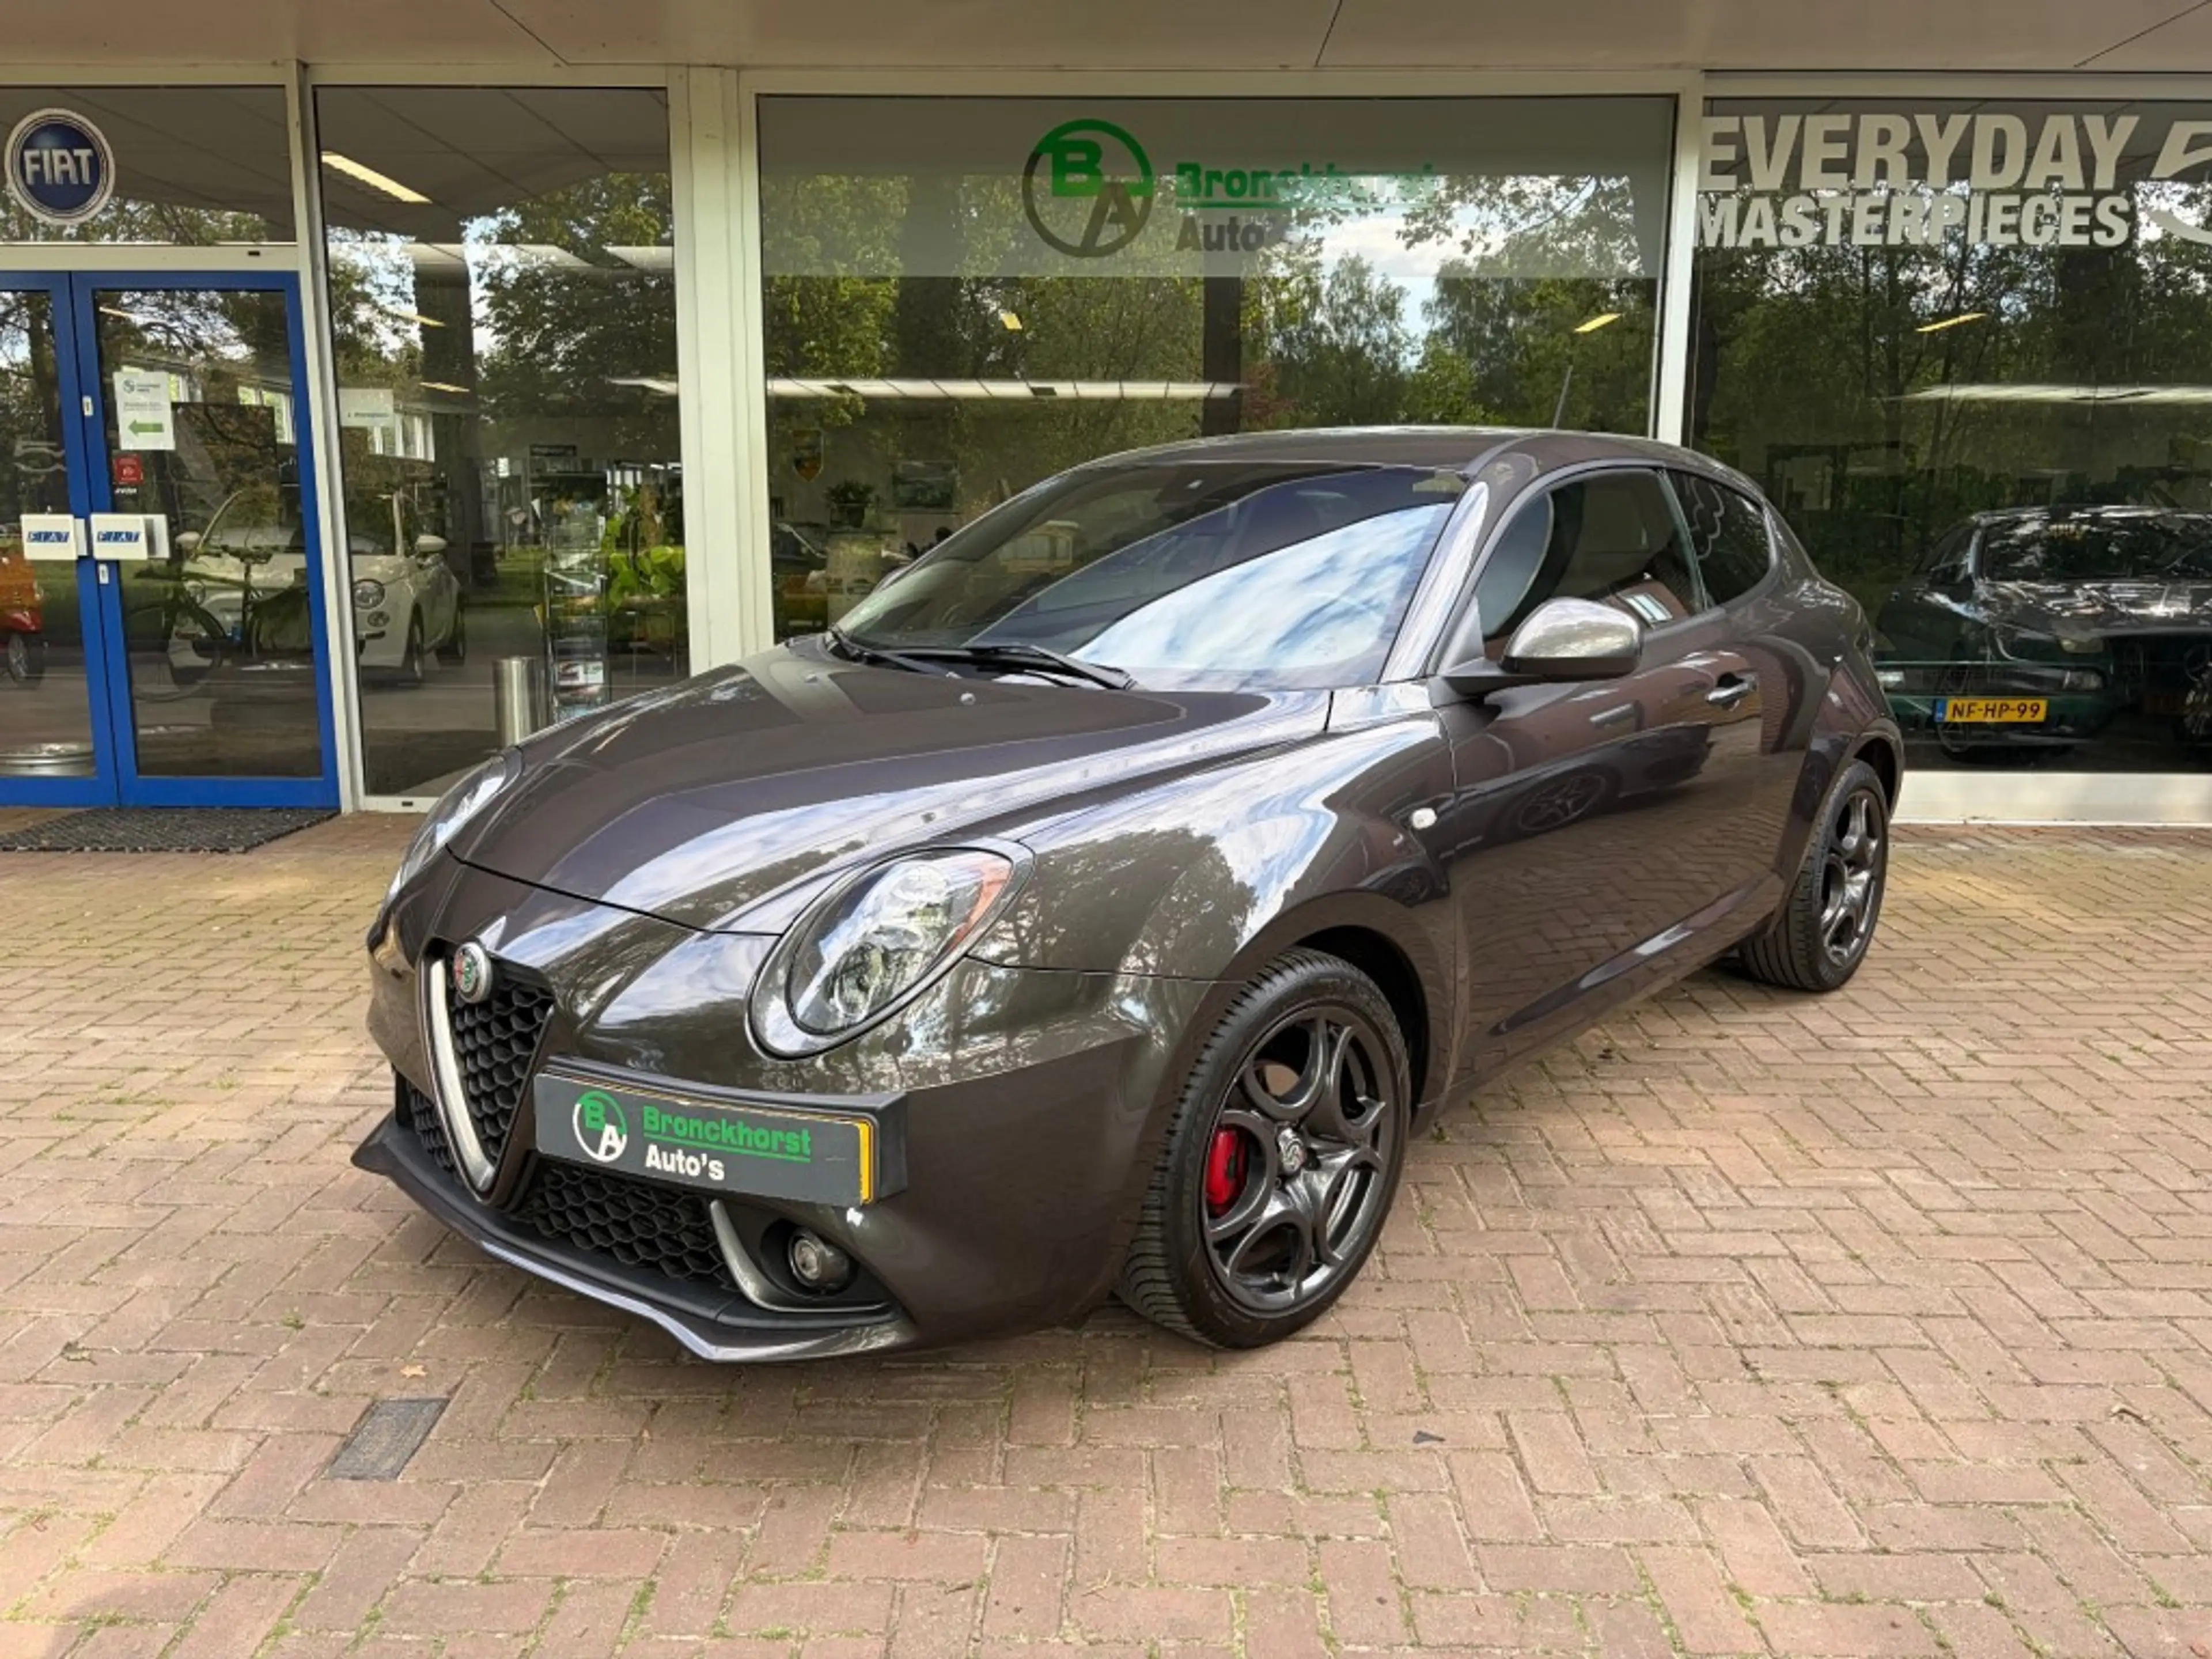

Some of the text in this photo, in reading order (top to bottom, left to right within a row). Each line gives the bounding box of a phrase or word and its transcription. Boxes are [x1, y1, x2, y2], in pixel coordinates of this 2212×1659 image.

[24, 149, 93, 185] FIAT
[1696, 114, 2141, 191] EVERYDAY
[1176, 161, 1437, 198] Bronckhorst
[1693, 194, 2131, 248] MASTERPIECES
[27, 531, 70, 543] FIAT
[97, 531, 140, 543] FIAT
[1952, 702, 2041, 719] NF-HP-99
[643, 1105, 812, 1155] Bronckhorst
[645, 1144, 725, 1181] Auto's
